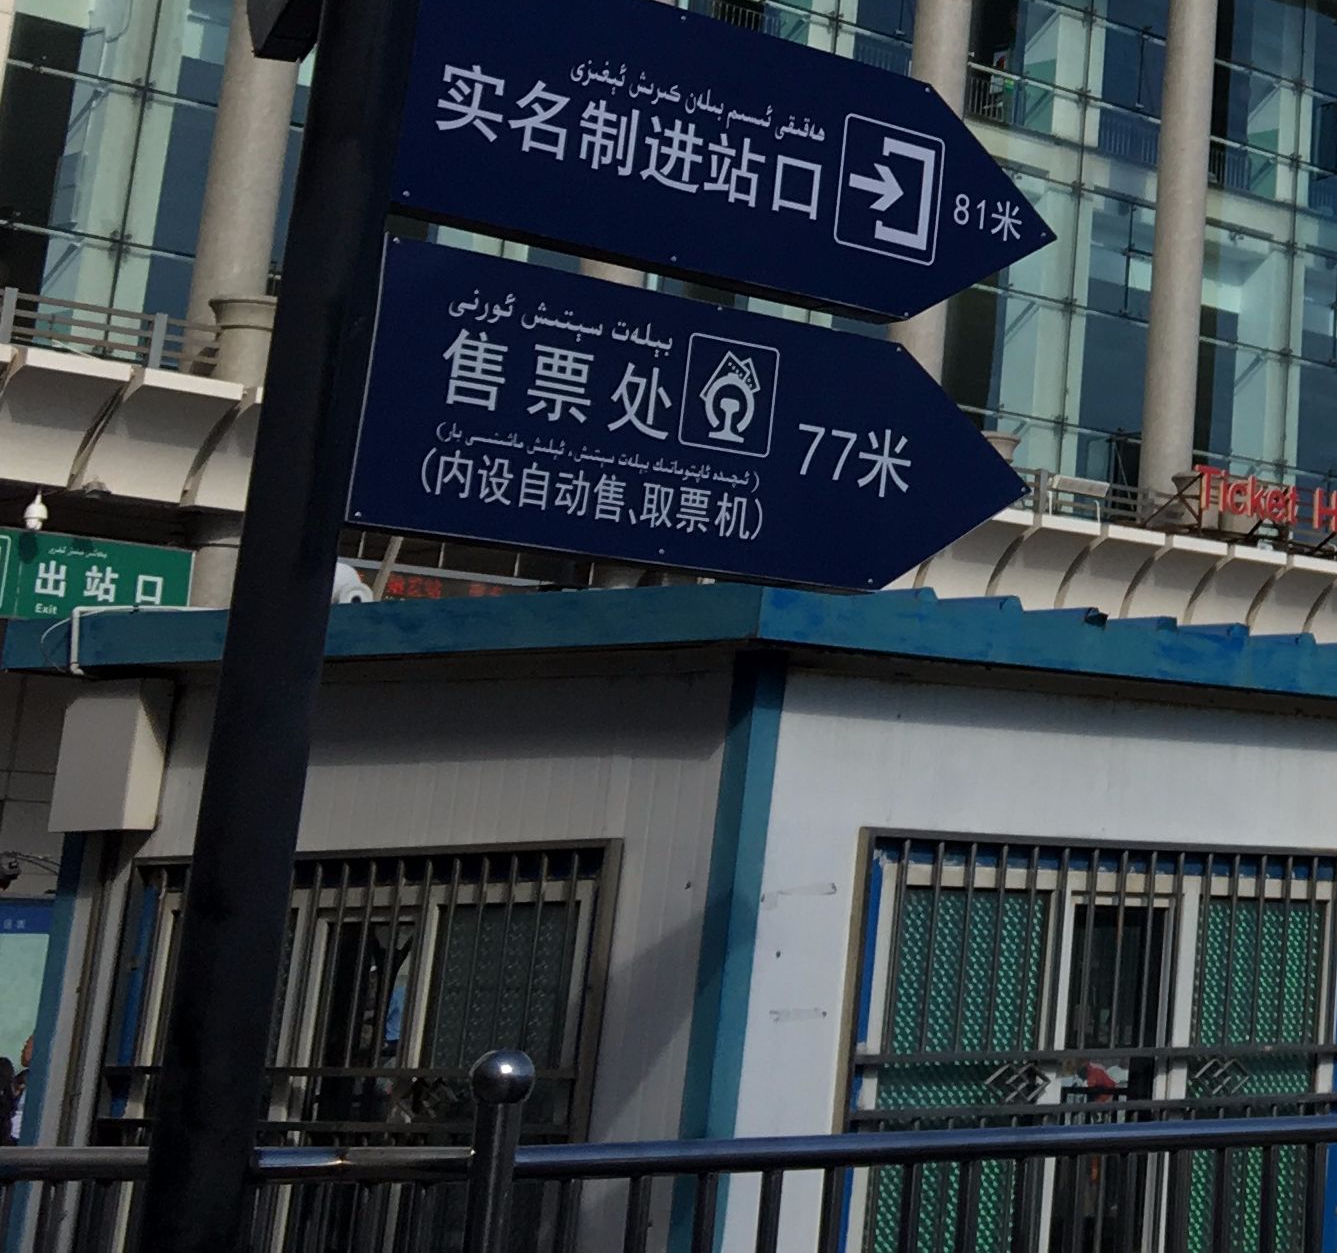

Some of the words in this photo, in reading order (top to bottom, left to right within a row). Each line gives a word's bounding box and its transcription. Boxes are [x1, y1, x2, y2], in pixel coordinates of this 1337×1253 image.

[434, 62, 824, 222] 实名制进站口
[952, 194, 1024, 242] 81米
[441, 329, 671, 443] 售票处
[797, 423, 913, 499] 77米
[1192, 463, 1299, 526] Ticket
[34, 559, 164, 606] 出站口
[34, 602, 58, 615] Exit
